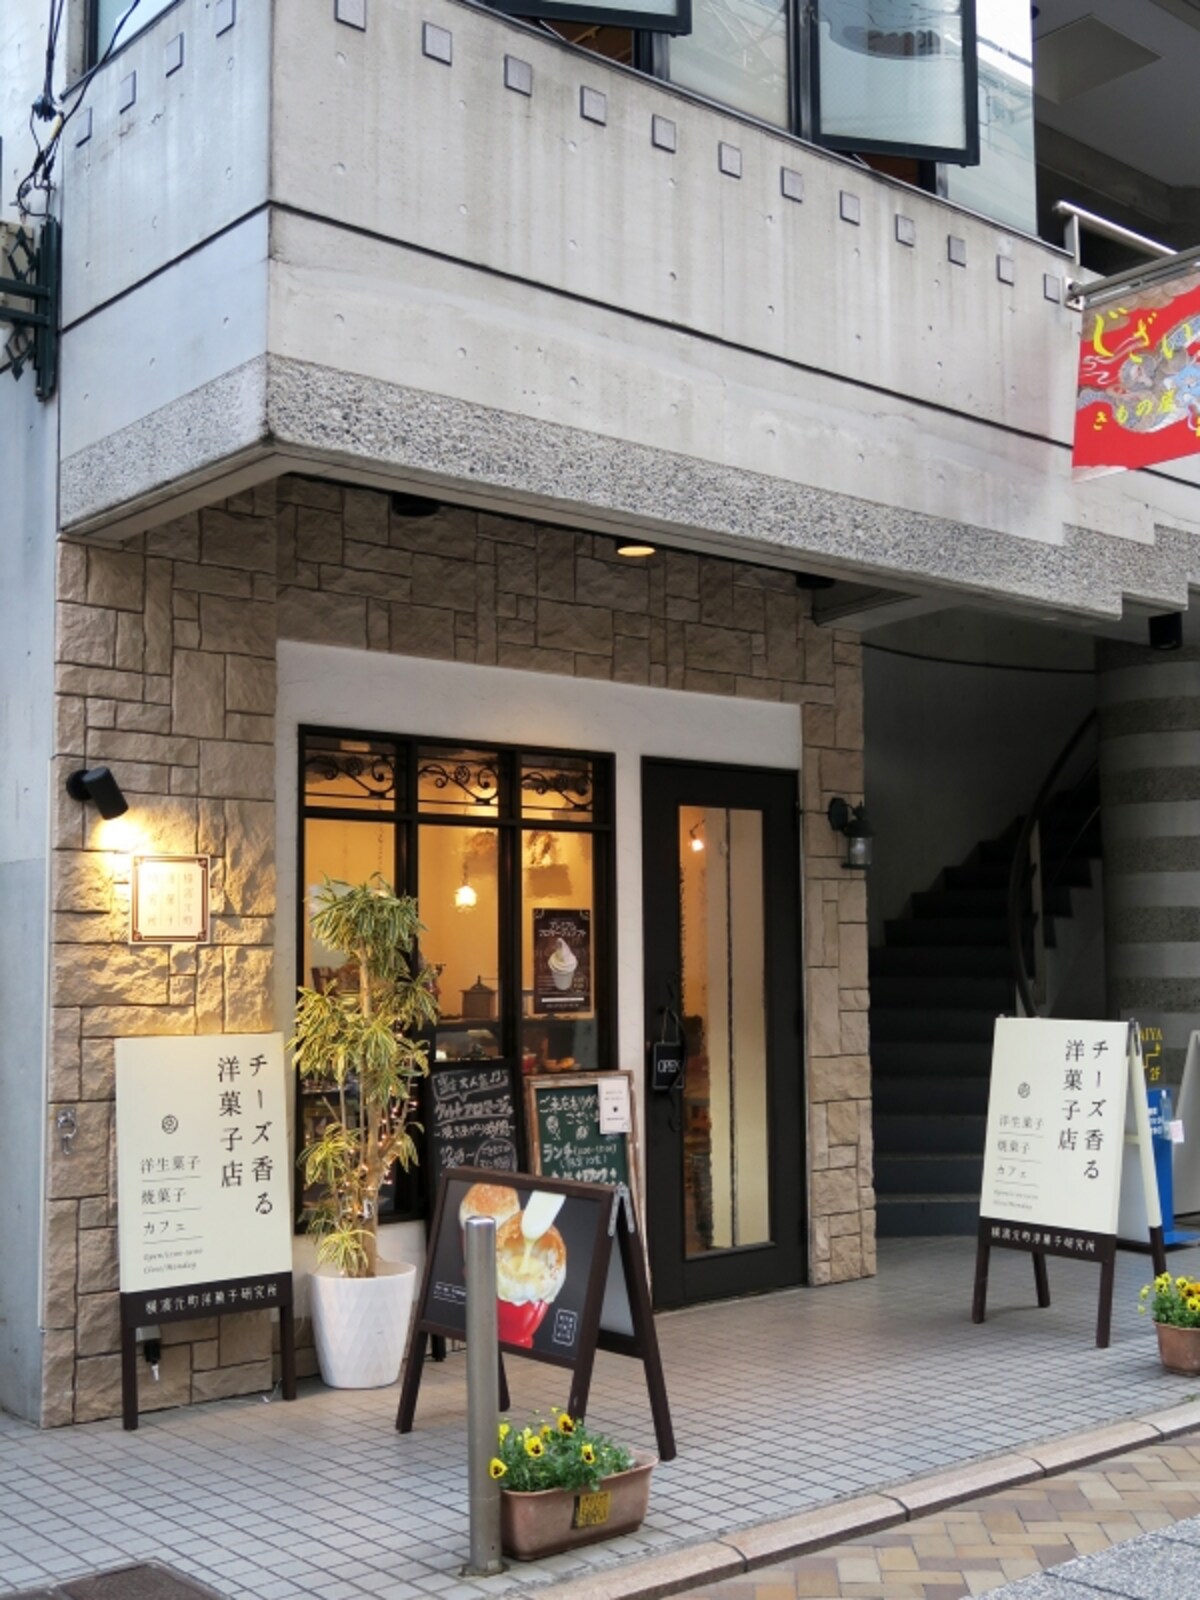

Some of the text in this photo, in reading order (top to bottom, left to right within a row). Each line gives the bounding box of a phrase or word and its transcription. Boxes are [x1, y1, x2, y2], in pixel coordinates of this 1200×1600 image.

[1058, 1039, 1085, 1152] 洋菓子店
[1084, 1040, 1109, 1180] チーズ香る
[217, 1055, 243, 1188] 洋菓子店
[999, 1114, 1044, 1131] 洋生菓子
[249, 1053, 273, 1215] チーズ香る
[543, 1142, 573, 1163] ランチ
[141, 1155, 200, 1174] 洋生菓子
[996, 1165, 1027, 1179] カフェ
[143, 1220, 186, 1236] カフェ
